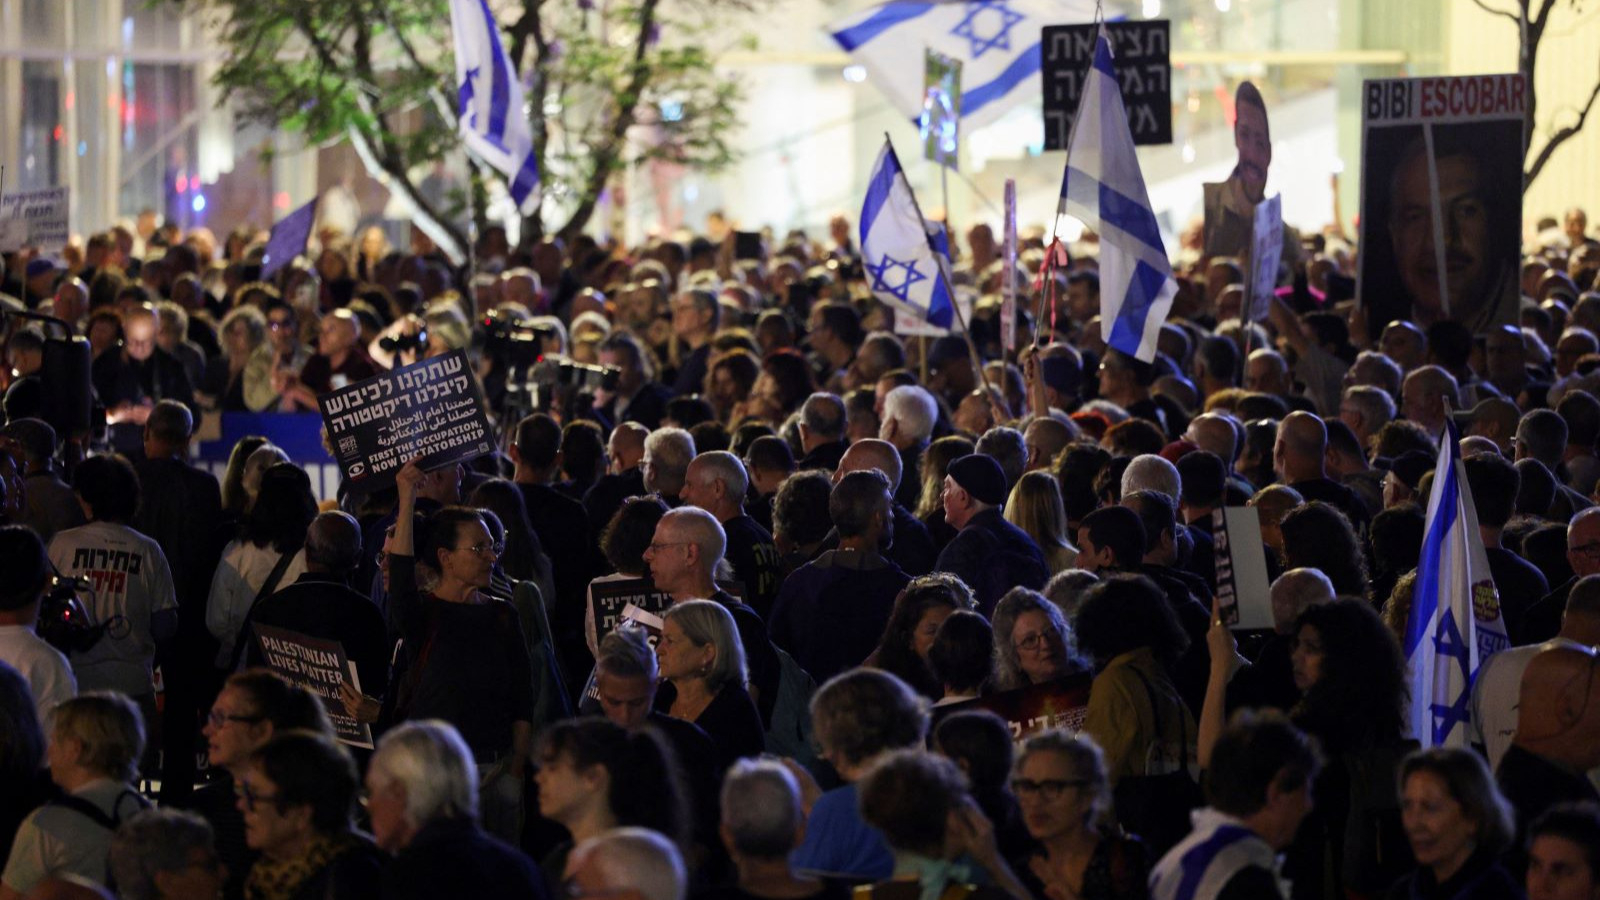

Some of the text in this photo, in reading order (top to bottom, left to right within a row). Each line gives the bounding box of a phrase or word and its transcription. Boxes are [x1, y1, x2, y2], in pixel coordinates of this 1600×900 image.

[1368, 76, 1525, 119] BIBI ESCOBAR
[325, 355, 463, 415] שתקנו לכיבוש
[331, 375, 468, 433] קיבלנו דיקטטורה
[368, 448, 394, 463] FIRST
[395, 441, 415, 454] THE
[415, 420, 482, 447] OCCUPATION,
[371, 457, 398, 474] NOW
[261, 635, 340, 668] PALESTINIAN
[268, 651, 343, 684] LIVES MATTER
